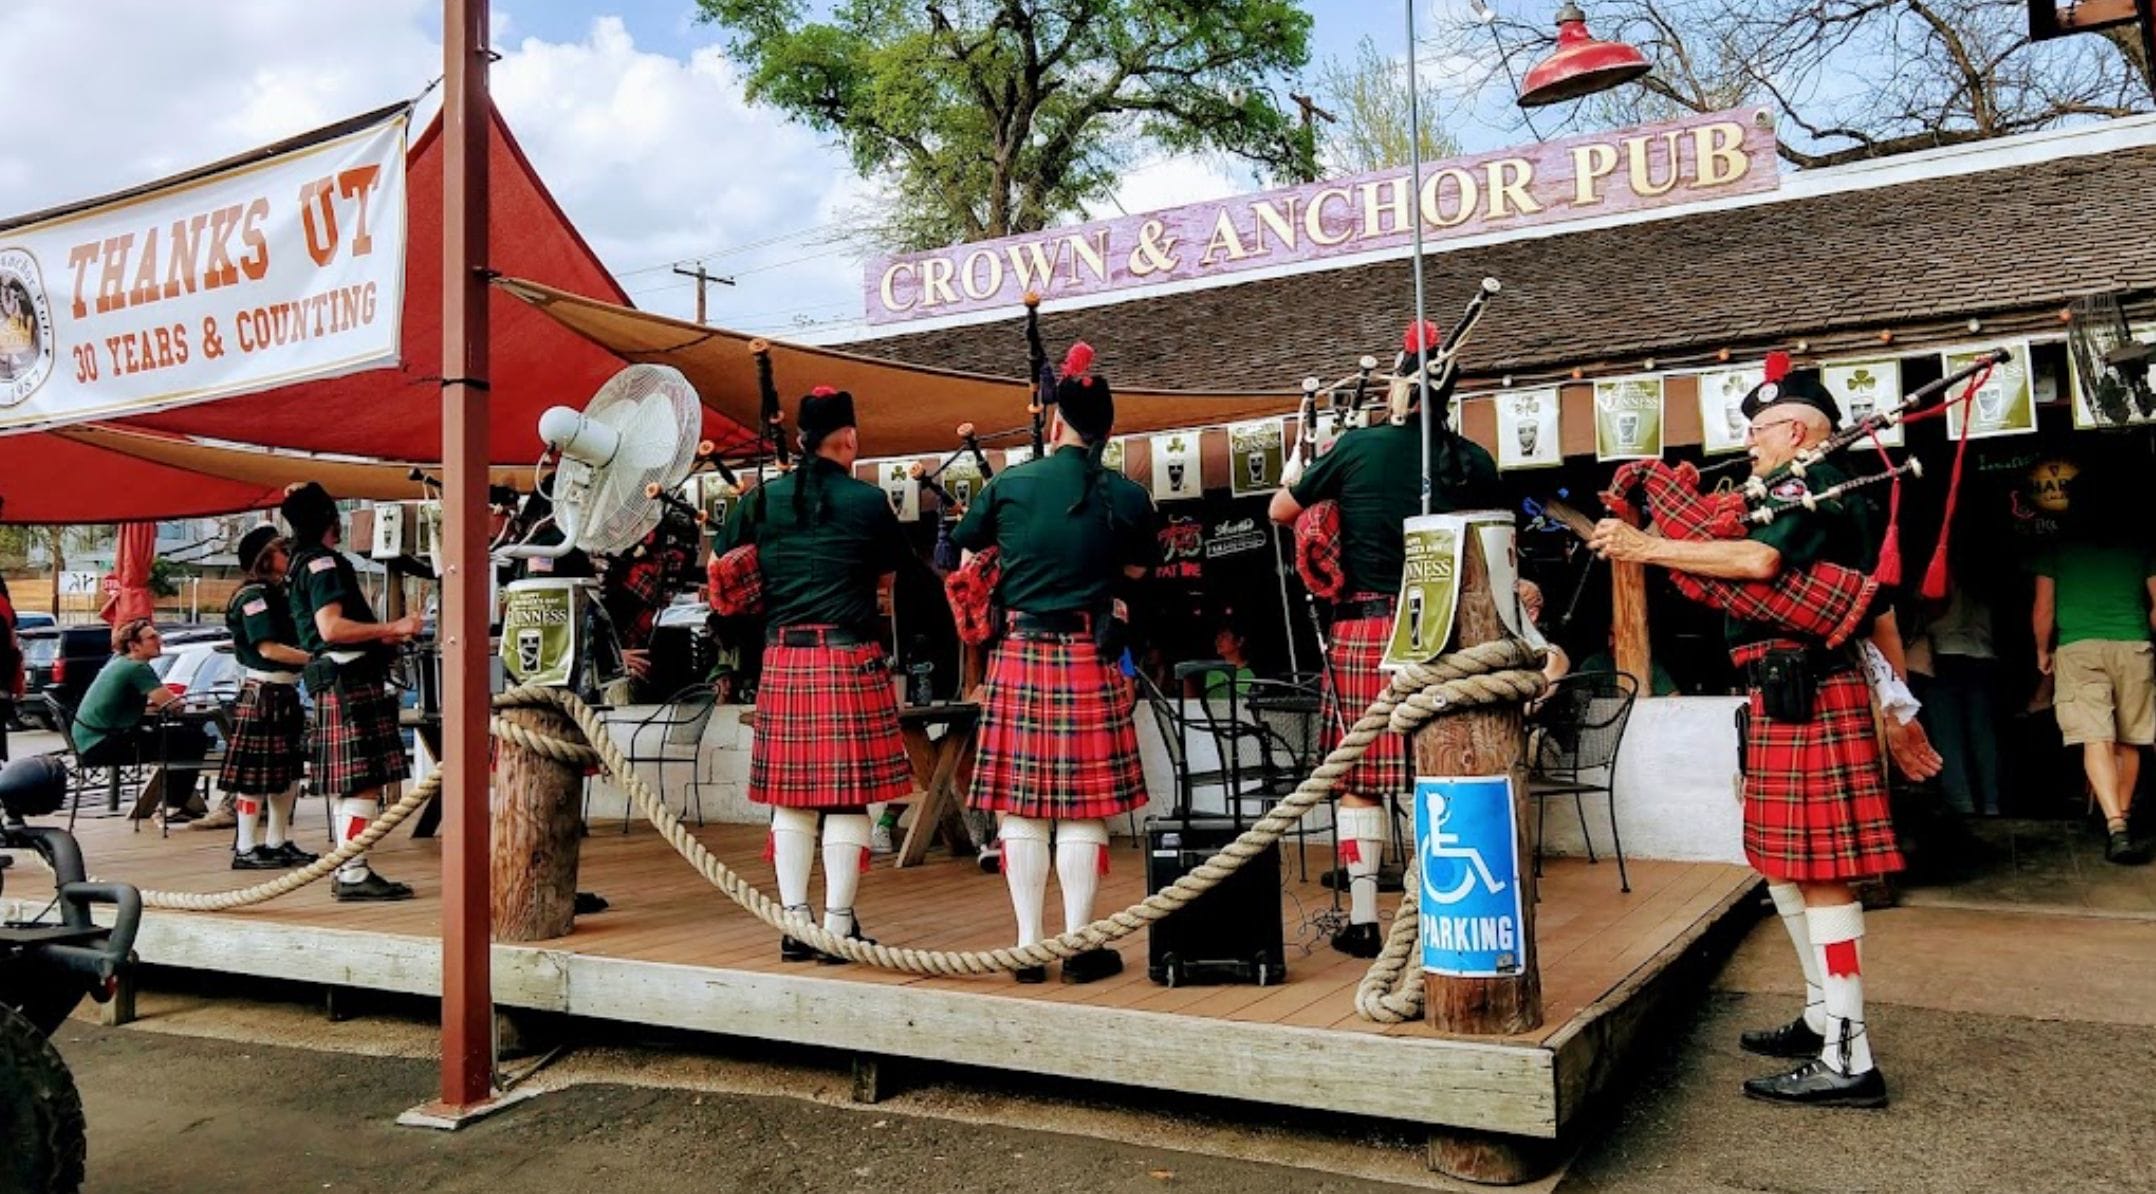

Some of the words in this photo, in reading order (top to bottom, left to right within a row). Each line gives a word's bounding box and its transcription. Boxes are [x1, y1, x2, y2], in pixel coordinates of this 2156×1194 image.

[68, 197, 270, 319] THANKS
[299, 163, 380, 266] UT
[880, 229, 1109, 312] CROWN
[1129, 221, 1181, 277] &
[1199, 158, 1543, 265] ANCHOR
[1571, 122, 1753, 205] PUB
[73, 341, 98, 383] 30
[106, 323, 189, 376] YEARS
[202, 315, 224, 359] &
[235, 280, 377, 352] COUNTING
[1422, 912, 1514, 951] PARKING
